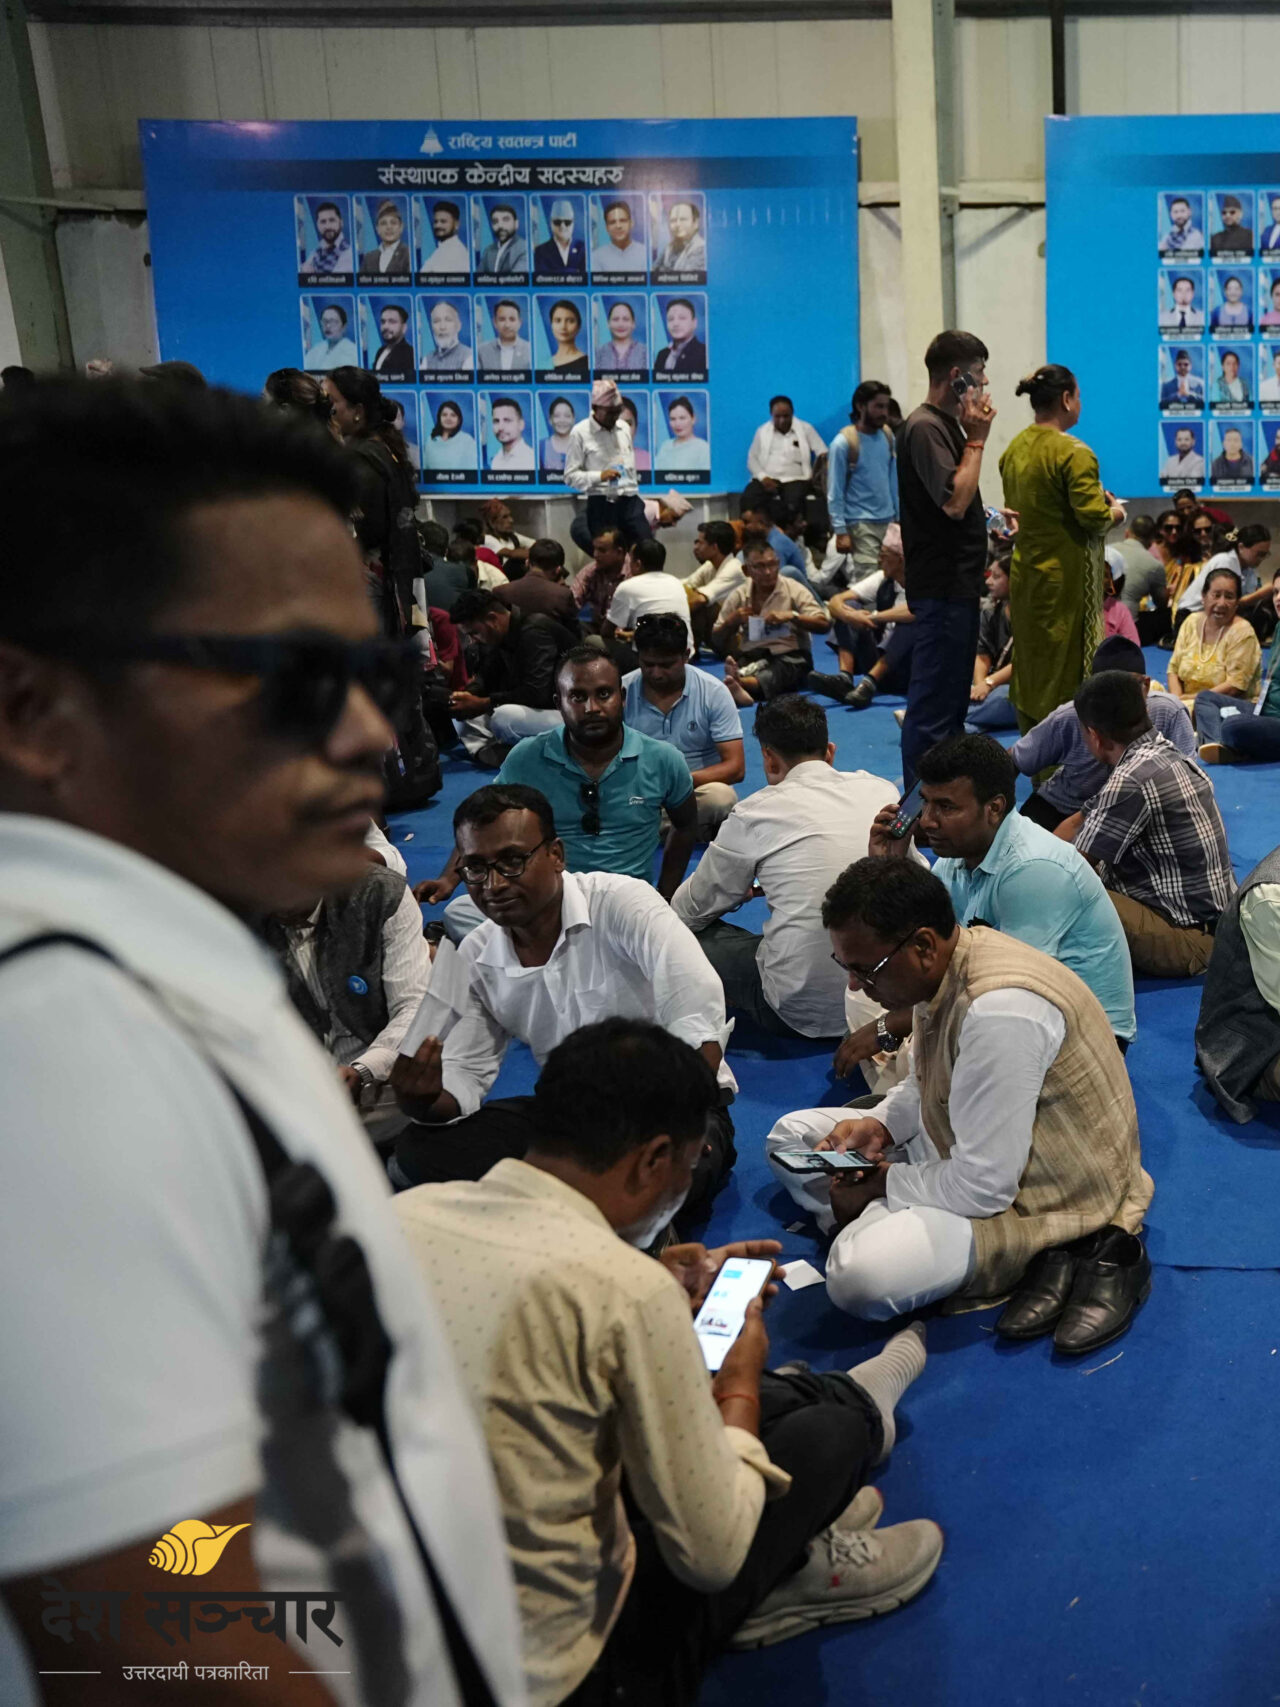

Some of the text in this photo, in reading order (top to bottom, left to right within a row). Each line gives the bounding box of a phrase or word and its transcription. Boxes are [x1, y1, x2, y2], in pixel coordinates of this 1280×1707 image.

[548, 132, 577, 148] पार्टी
[377, 164, 459, 185] संस्थापक
[465, 162, 530, 186] केन्द्रीय
